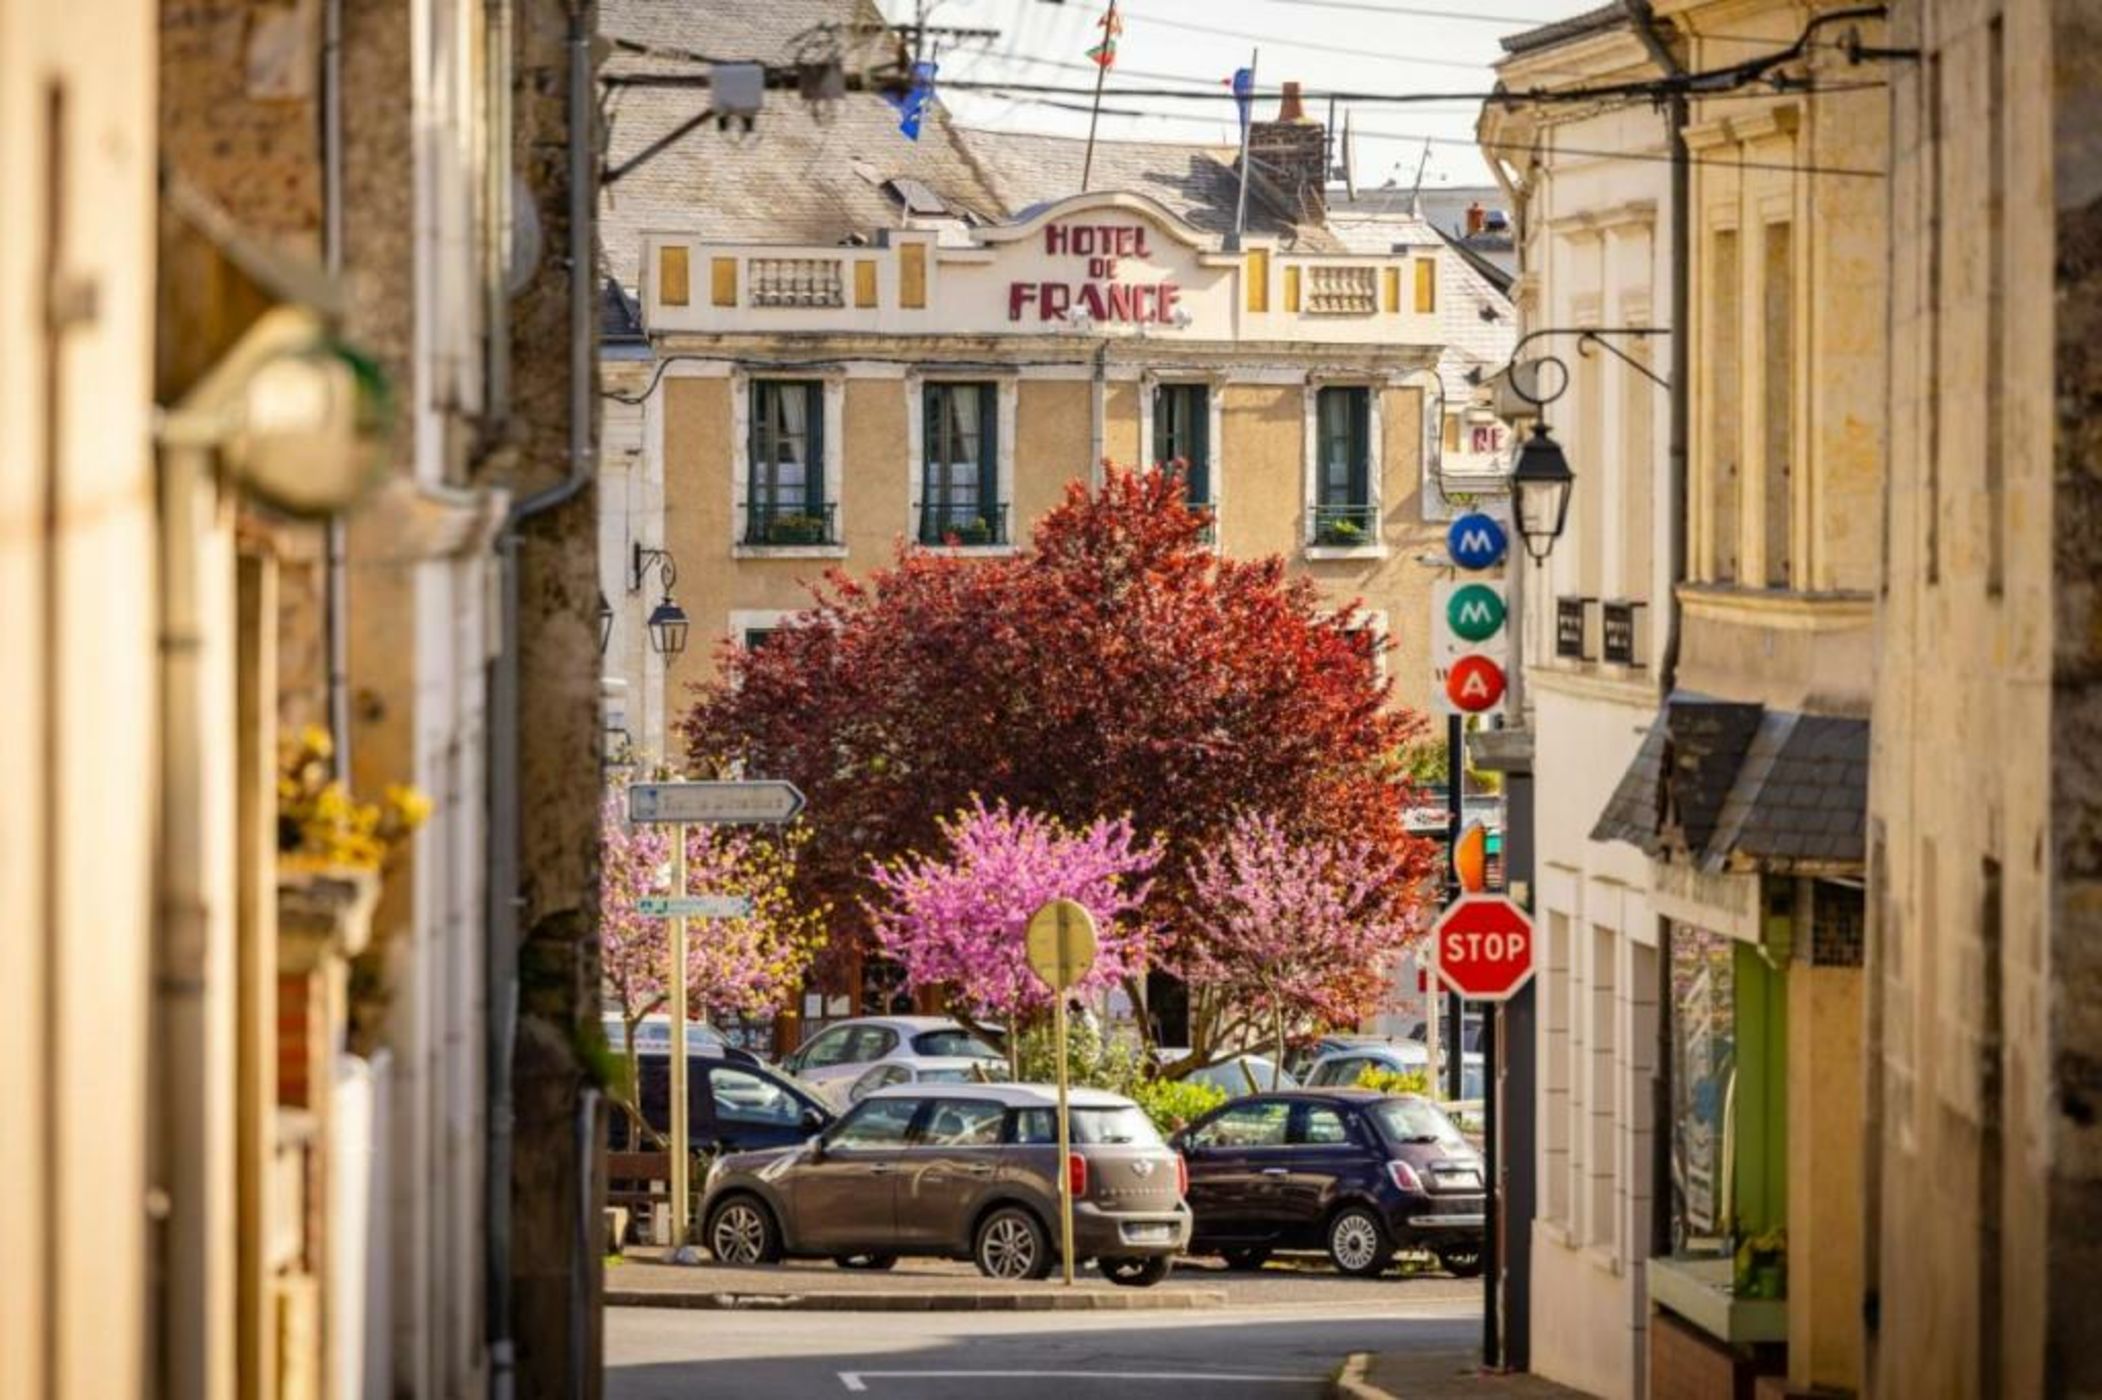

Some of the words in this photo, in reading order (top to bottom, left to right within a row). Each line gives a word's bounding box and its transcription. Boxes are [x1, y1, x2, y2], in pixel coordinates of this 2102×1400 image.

[1045, 224, 1151, 257] HOTEL
[1088, 257, 1116, 279] DE
[1008, 282, 1180, 324] FRANCE
[1460, 529, 1491, 553] M
[1460, 600, 1491, 624] M
[1461, 669, 1488, 698] A
[1447, 933, 1525, 962] STOP
